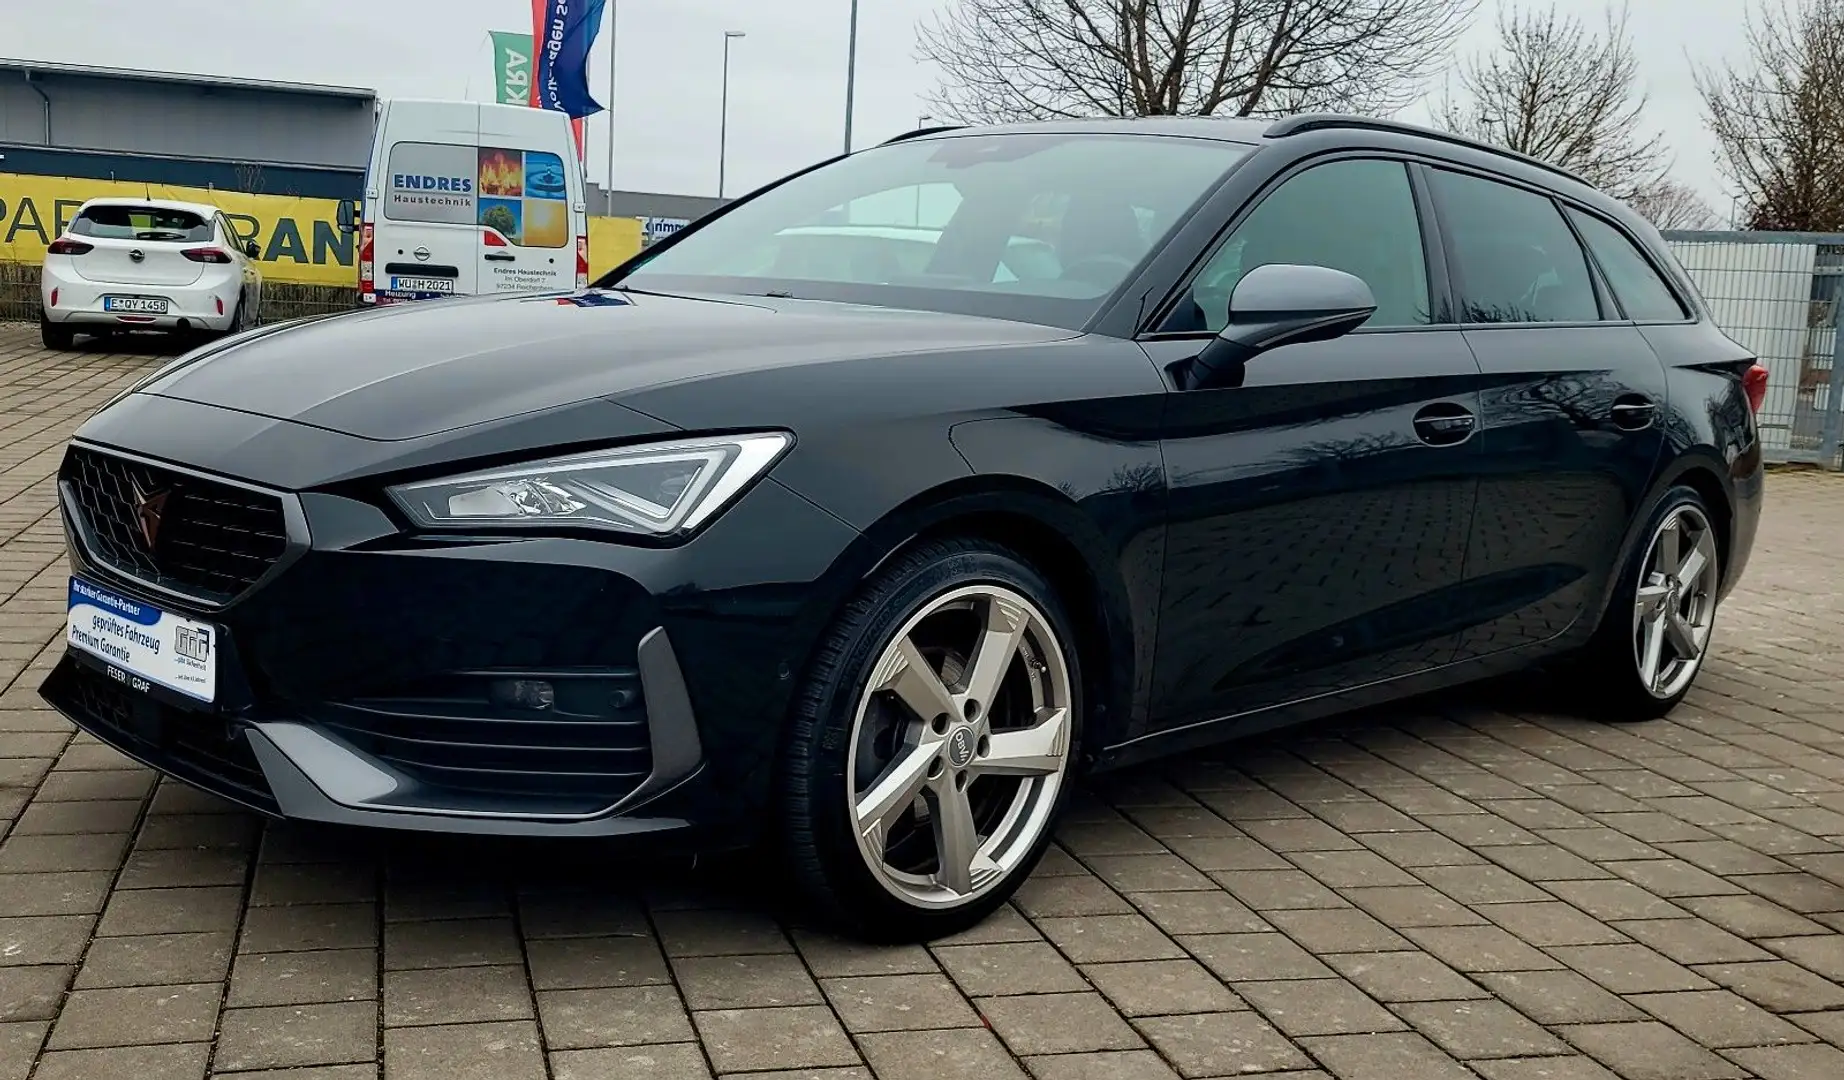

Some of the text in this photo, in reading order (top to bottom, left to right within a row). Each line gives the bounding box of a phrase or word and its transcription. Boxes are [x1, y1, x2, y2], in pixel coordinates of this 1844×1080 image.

[394, 174, 472, 193] ENDRES
[394, 194, 472, 207] Haustechnik
[494, 267, 516, 275] Endres
[398, 279, 451, 291] WÜ H 2021
[111, 299, 118, 308] E
[140, 300, 166, 310] 1458
[92, 614, 161, 655] geprüftes Fahrzeug
[72, 625, 131, 663] Premium Garantie
[107, 665, 150, 693] FESER GRAF
